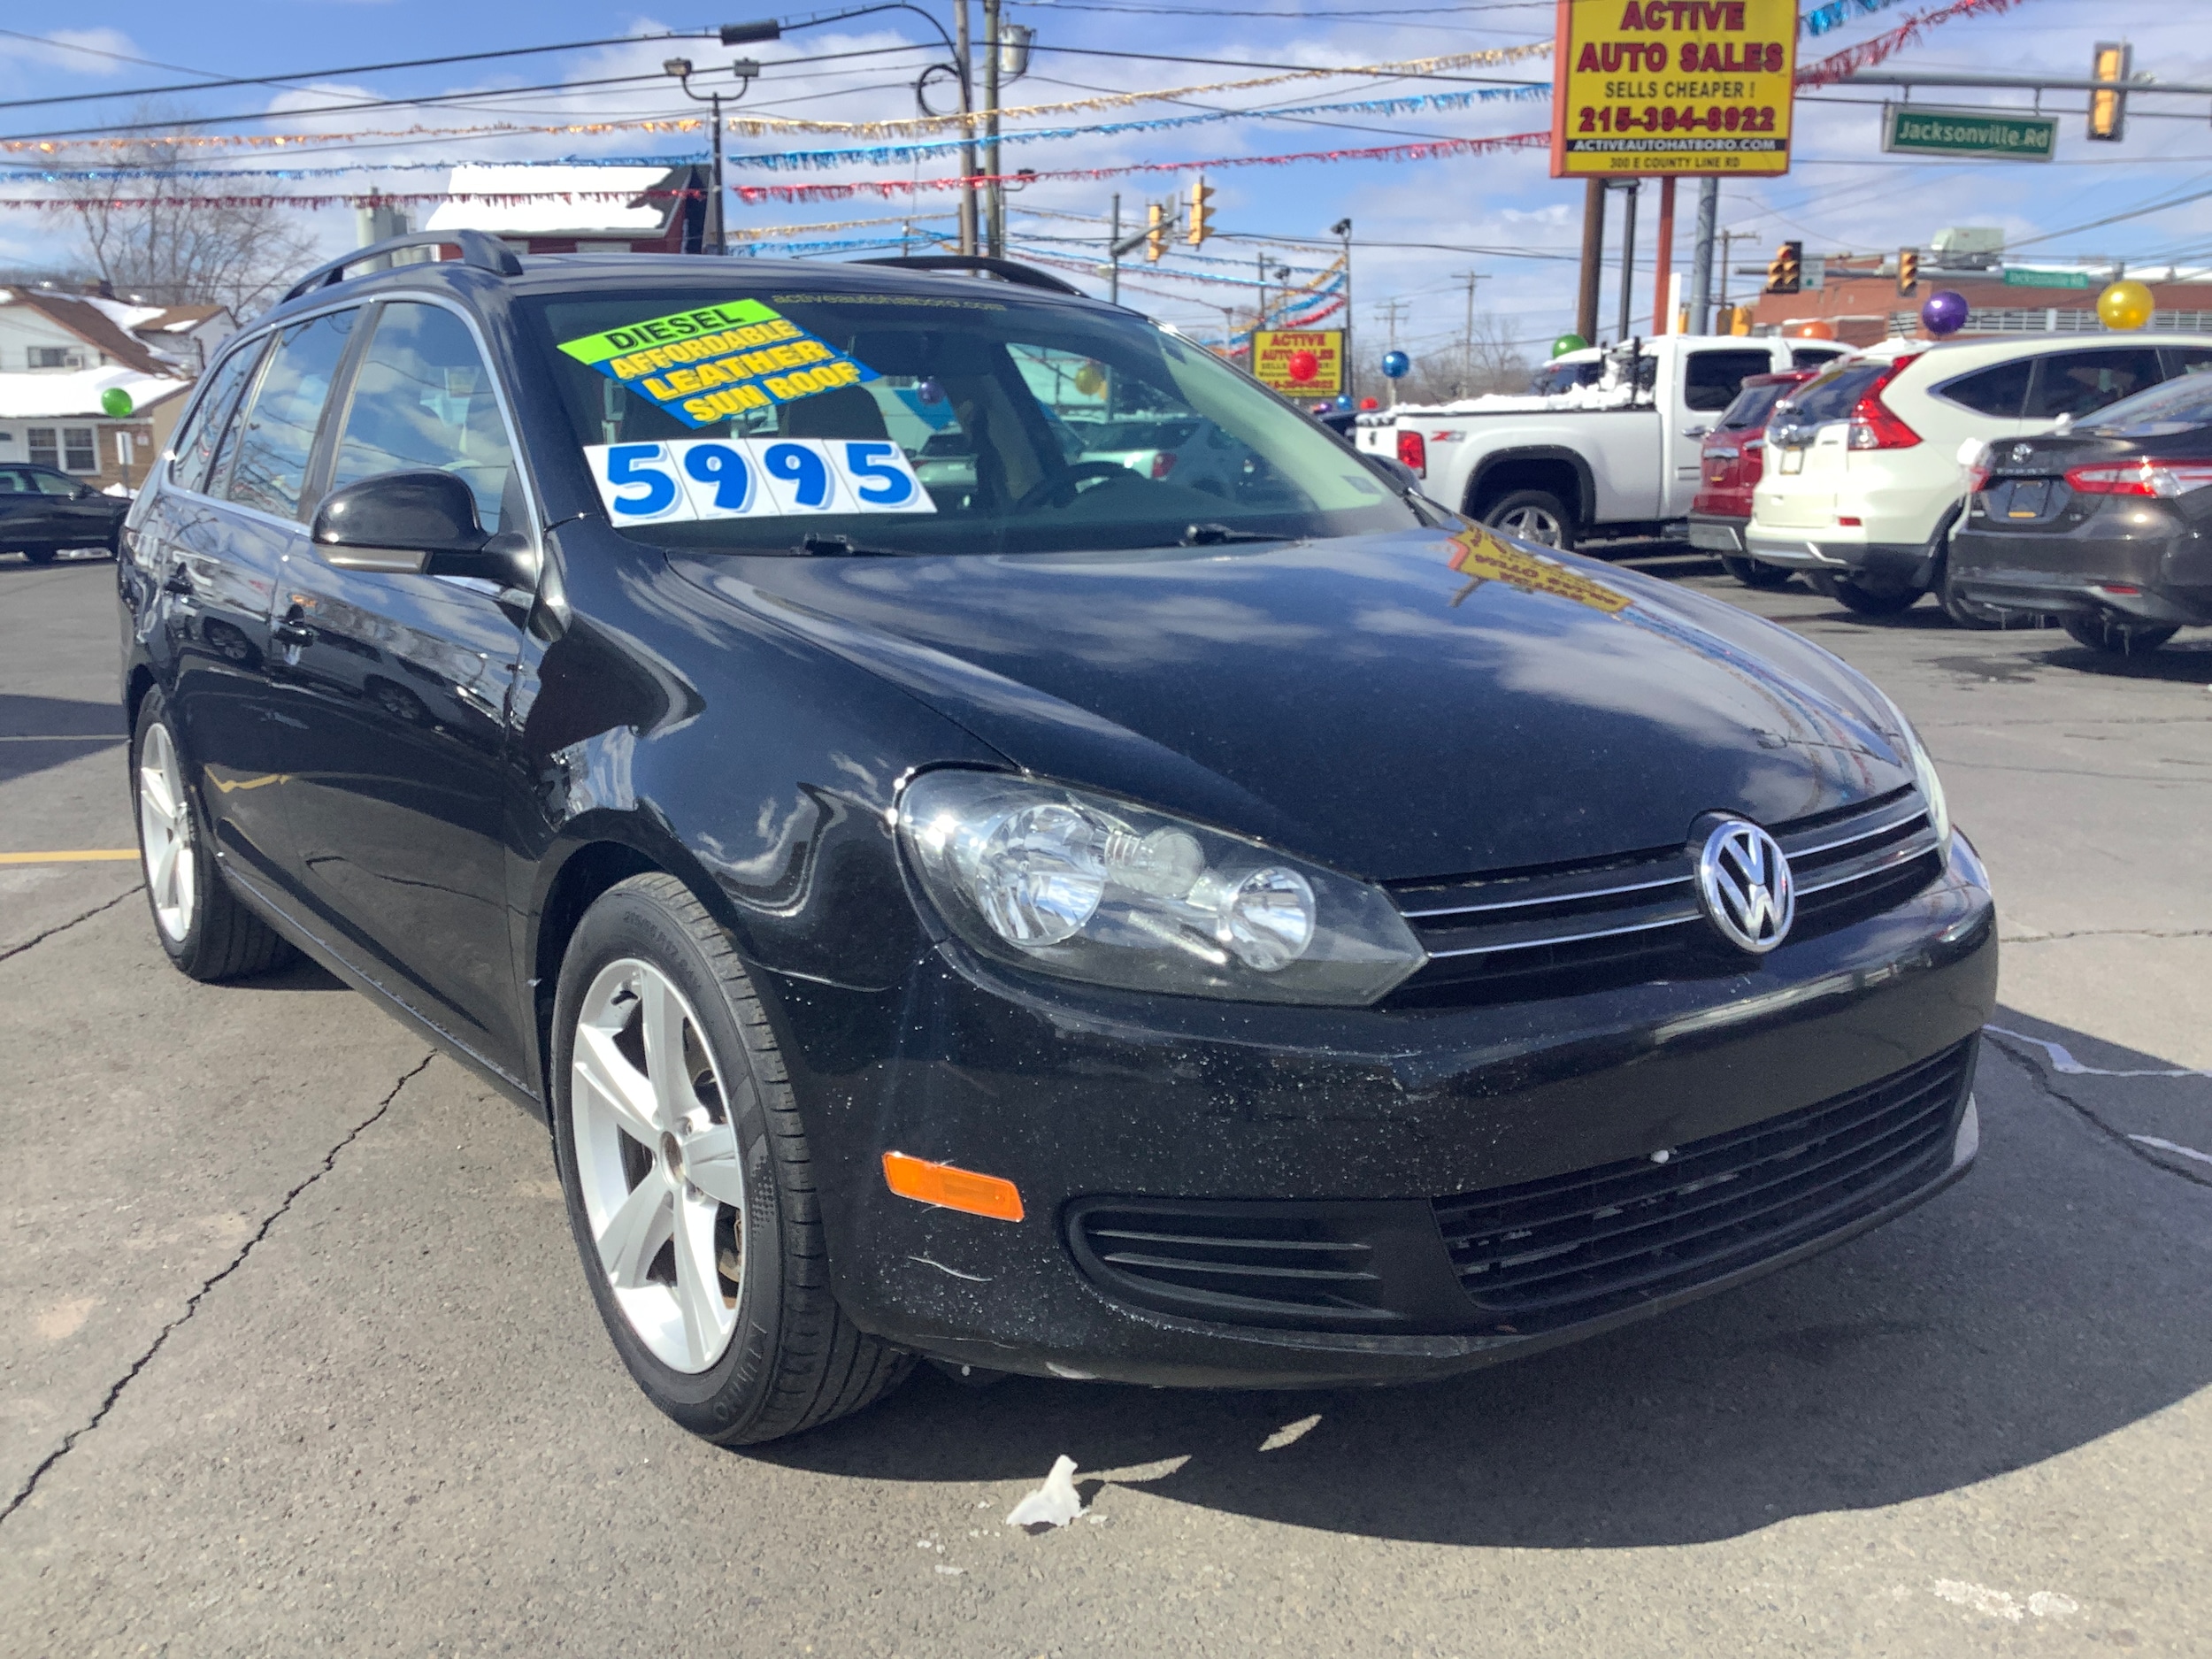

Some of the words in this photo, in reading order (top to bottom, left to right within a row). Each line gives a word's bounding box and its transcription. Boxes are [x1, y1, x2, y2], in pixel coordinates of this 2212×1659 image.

[1619, 0, 1746, 31] ACTIVE
[1576, 42, 1668, 73] AUTO
[1679, 42, 1784, 73] SALES
[1605, 81, 1657, 98] SELLS
[1663, 81, 1744, 98] CHEAPER
[1578, 106, 1775, 132] 215-394-8922
[1897, 120, 2020, 146] Jacksonville
[2023, 127, 2050, 149] Rd
[1573, 139, 1776, 151] ACTIVEAUTOHATBORO.COM
[1609, 157, 1630, 168] 300
[1633, 157, 1640, 168] E
[1643, 157, 1692, 168] COUNTY
[1695, 157, 1721, 168] LINE
[1724, 157, 1740, 168] RD
[604, 310, 744, 349] DIESEL
[610, 319, 804, 380] AFFORDABLE
[641, 340, 835, 401] LEATHER
[682, 384, 772, 423] SUN
[763, 361, 862, 400] ROOF
[607, 442, 918, 517] 5995
